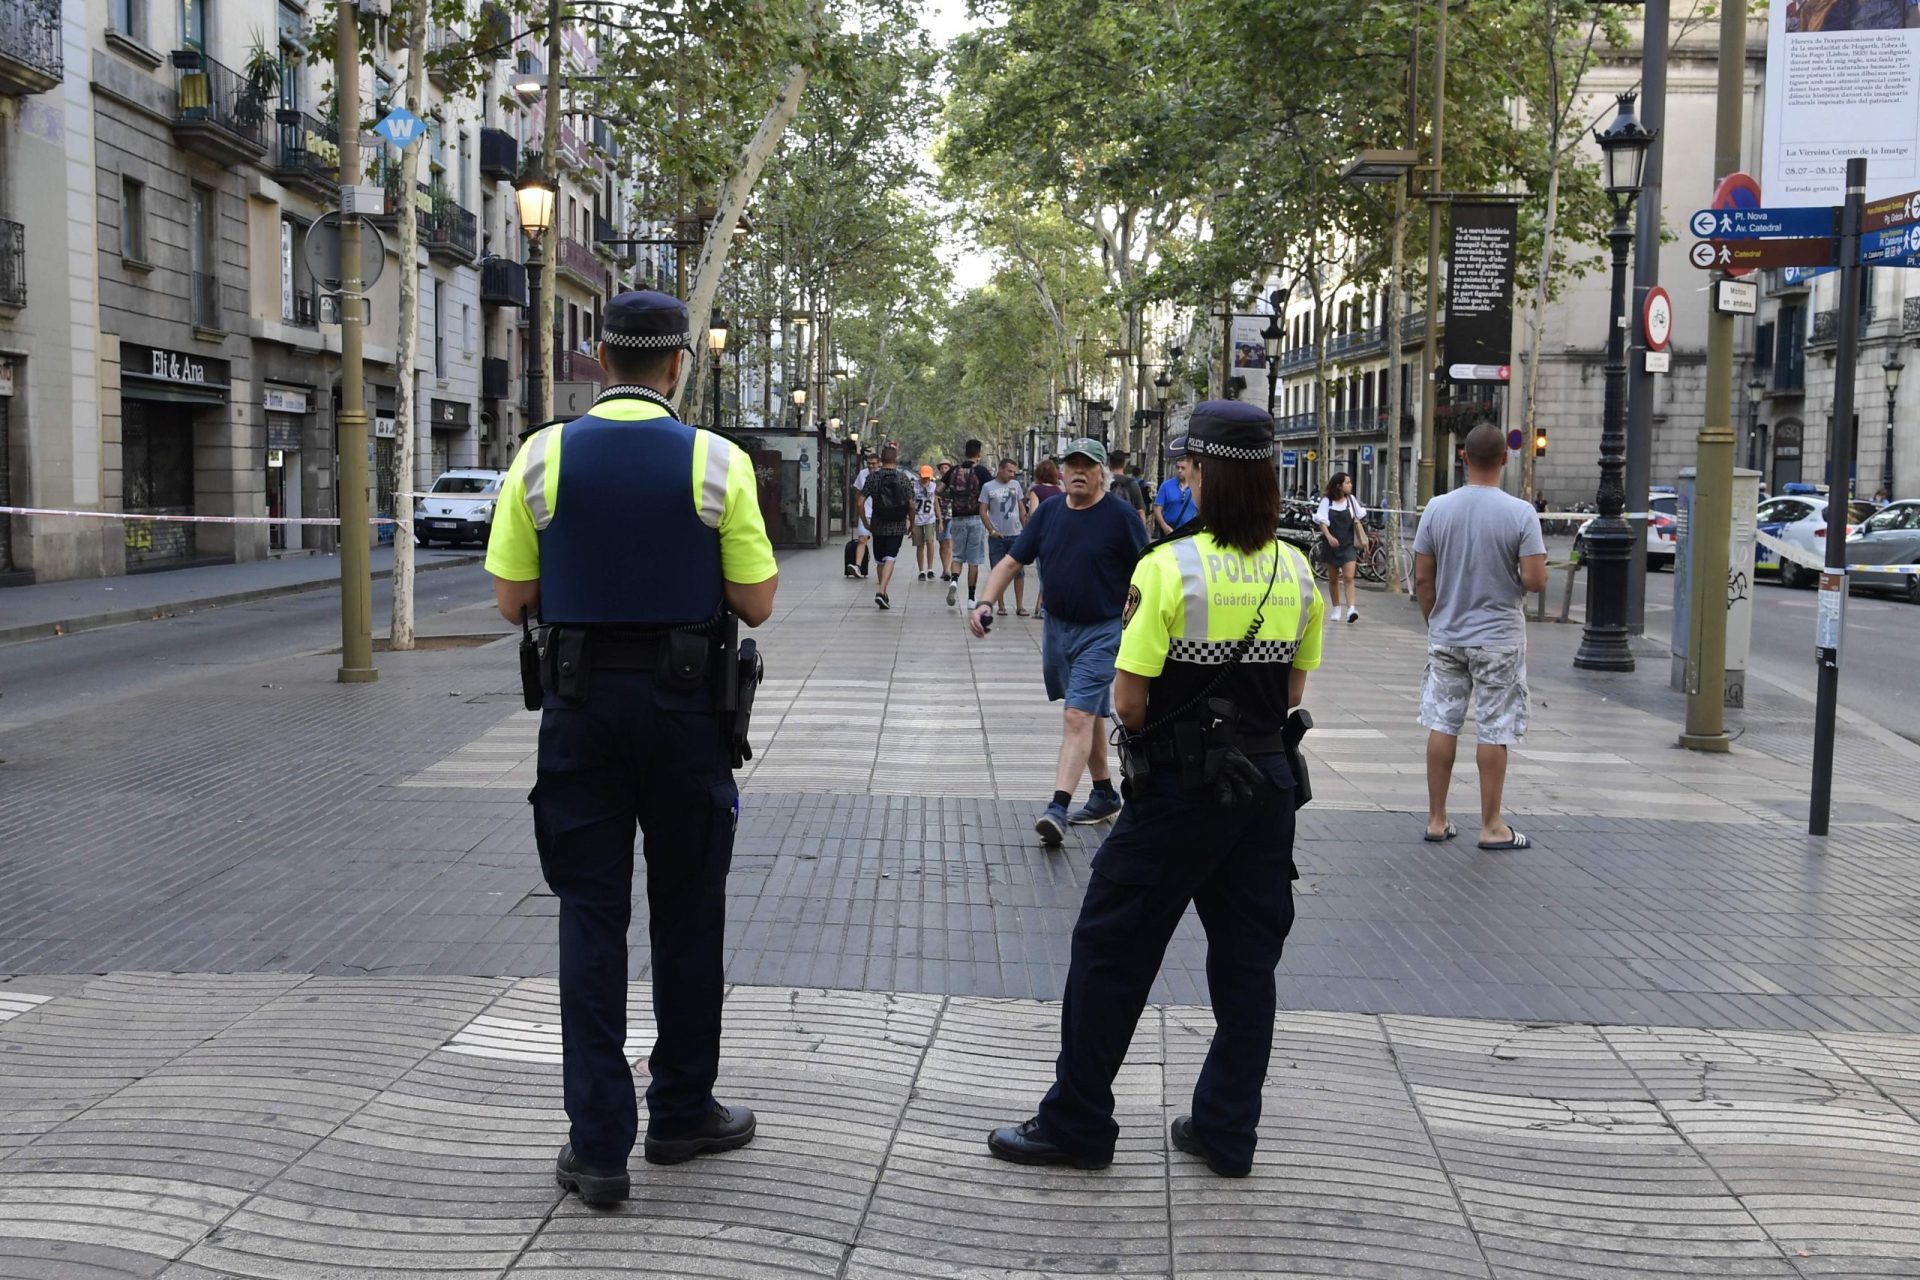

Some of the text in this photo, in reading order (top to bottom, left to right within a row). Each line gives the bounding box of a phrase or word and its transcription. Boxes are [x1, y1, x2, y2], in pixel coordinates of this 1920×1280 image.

[387, 119, 414, 138] W
[1787, 149, 1797, 157] La
[1800, 148, 1830, 156] Virreina
[1860, 147, 1869, 155] de
[1881, 147, 1909, 155] Imatge
[1735, 213, 1768, 221] Pl. Nova
[1735, 224, 1782, 232] Av. Catedral
[1735, 250, 1762, 258] Catedral
[152, 350, 205, 383] Eli & Ana
[916, 500, 932, 514] 76
[1207, 552, 1295, 584] POLICIA
